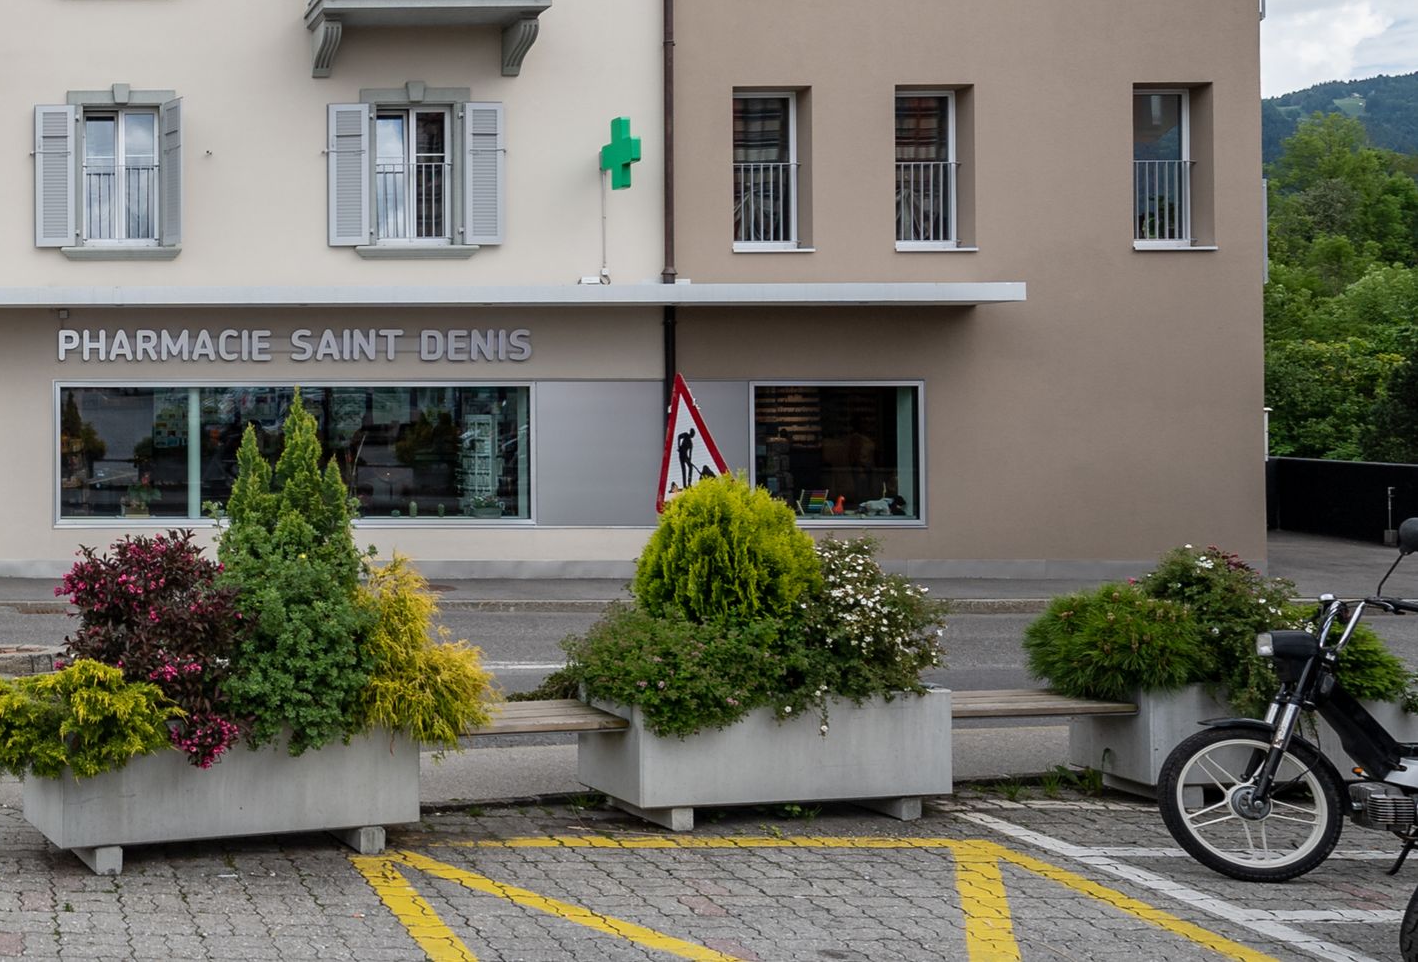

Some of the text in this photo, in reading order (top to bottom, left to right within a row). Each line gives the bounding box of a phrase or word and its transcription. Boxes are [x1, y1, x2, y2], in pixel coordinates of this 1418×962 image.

[58, 329, 531, 362] PHARMACIE SAINT DENIS
